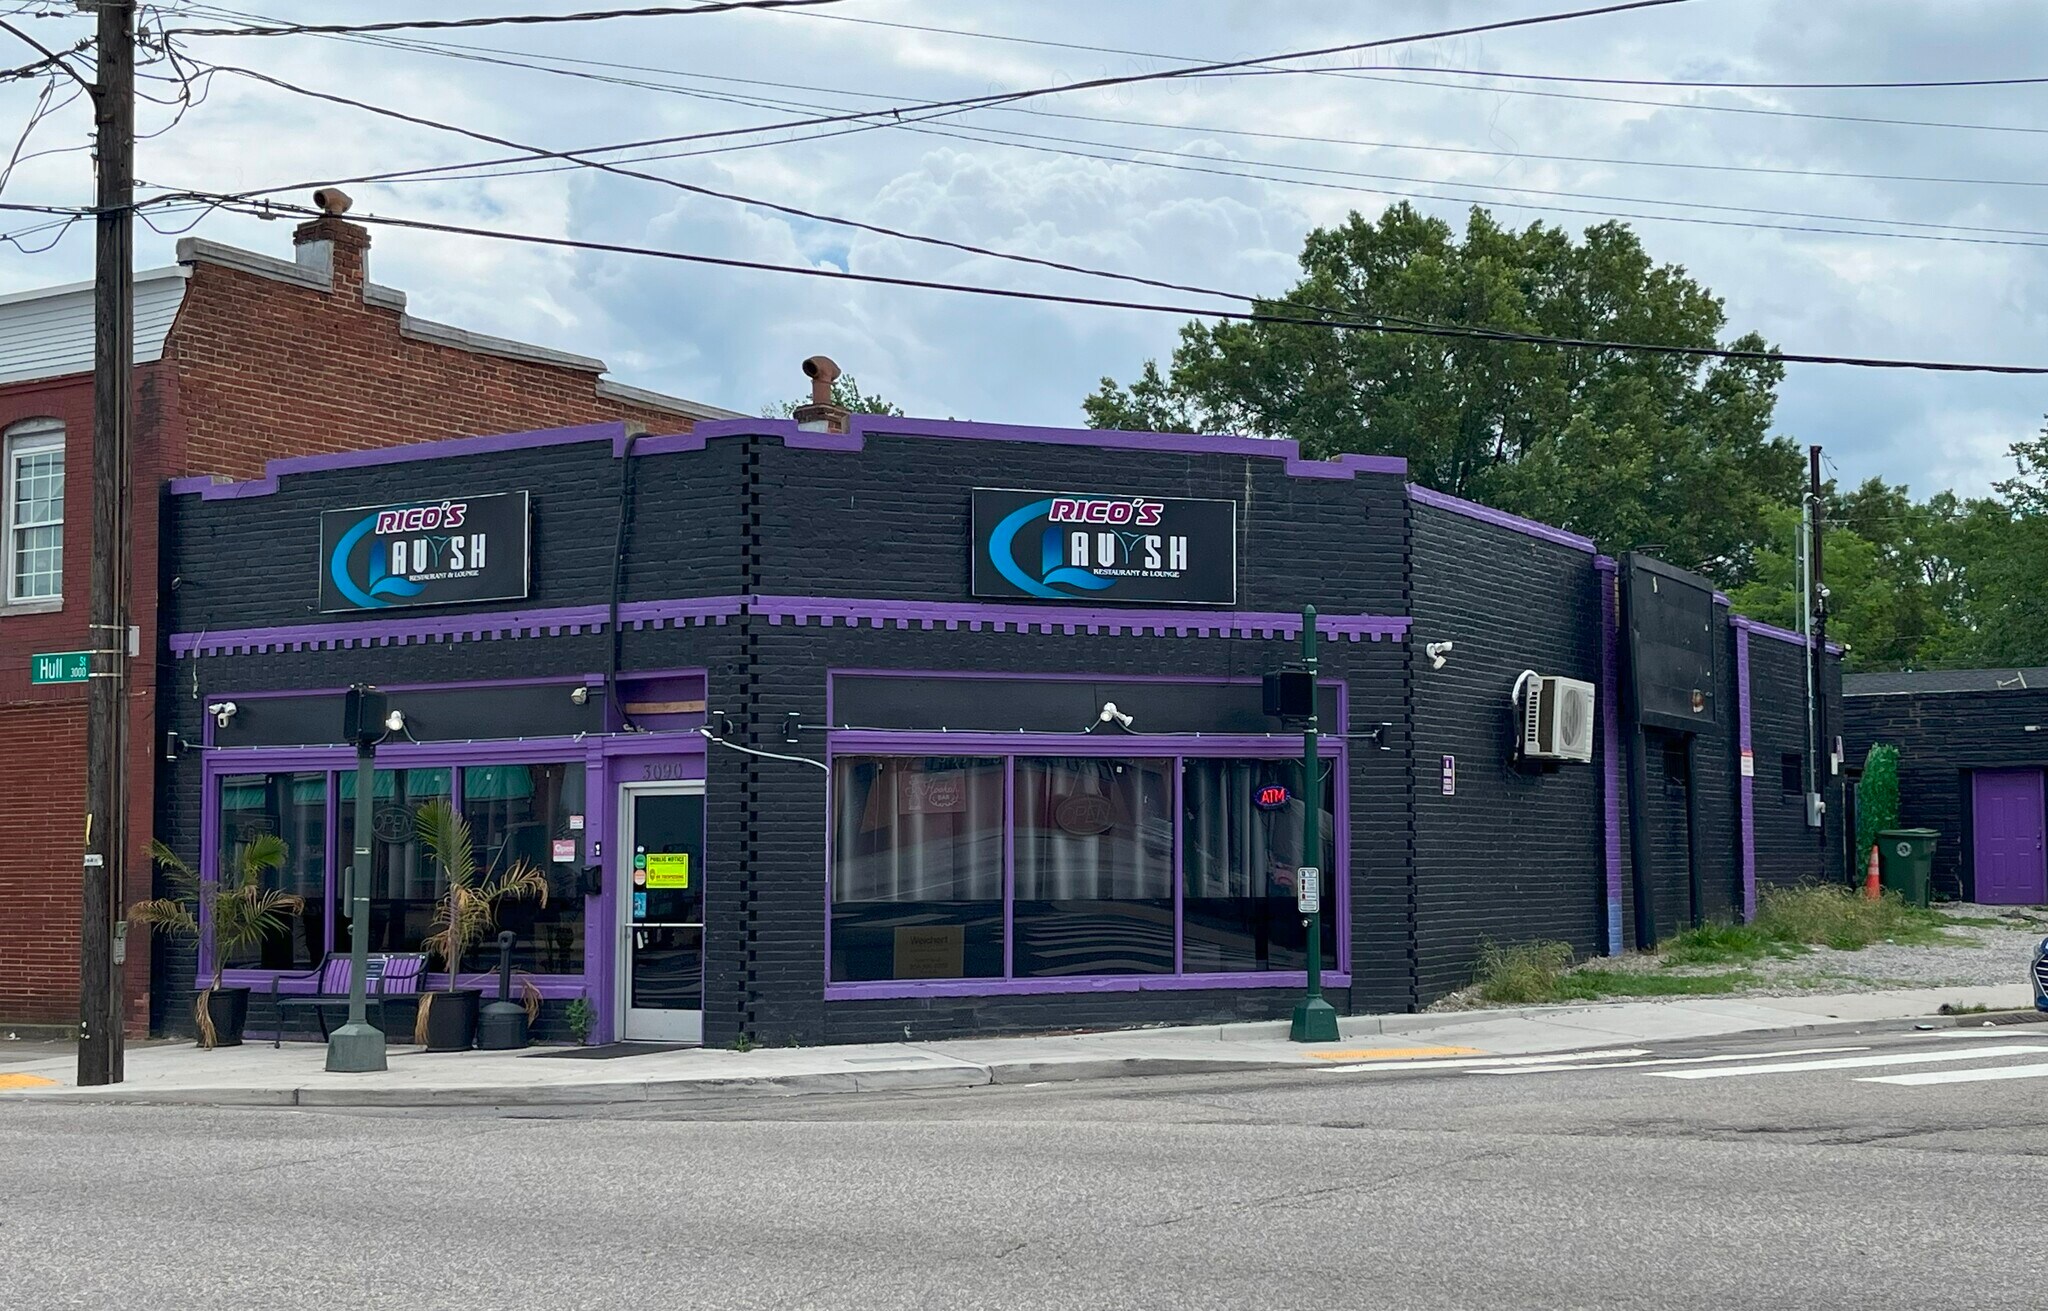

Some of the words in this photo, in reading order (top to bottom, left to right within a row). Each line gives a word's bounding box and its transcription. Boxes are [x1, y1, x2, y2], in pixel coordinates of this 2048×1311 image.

[375, 501, 468, 535] RICO'S
[1048, 498, 1163, 526] RICO'S
[409, 571, 448, 582] RESTAURANT
[454, 570, 480, 579] LOUNGE
[1093, 568, 1141, 577] RESTAURANT
[1149, 570, 1181, 578] LOUNGE
[40, 658, 62, 679] Hull
[79, 657, 87, 666] St
[70, 667, 87, 678] 3000
[642, 763, 683, 780] 3090
[1261, 788, 1285, 803] ATM
[1062, 805, 1110, 825] OPEN
[373, 814, 412, 833] OPEN
[555, 843, 574, 854] Open
